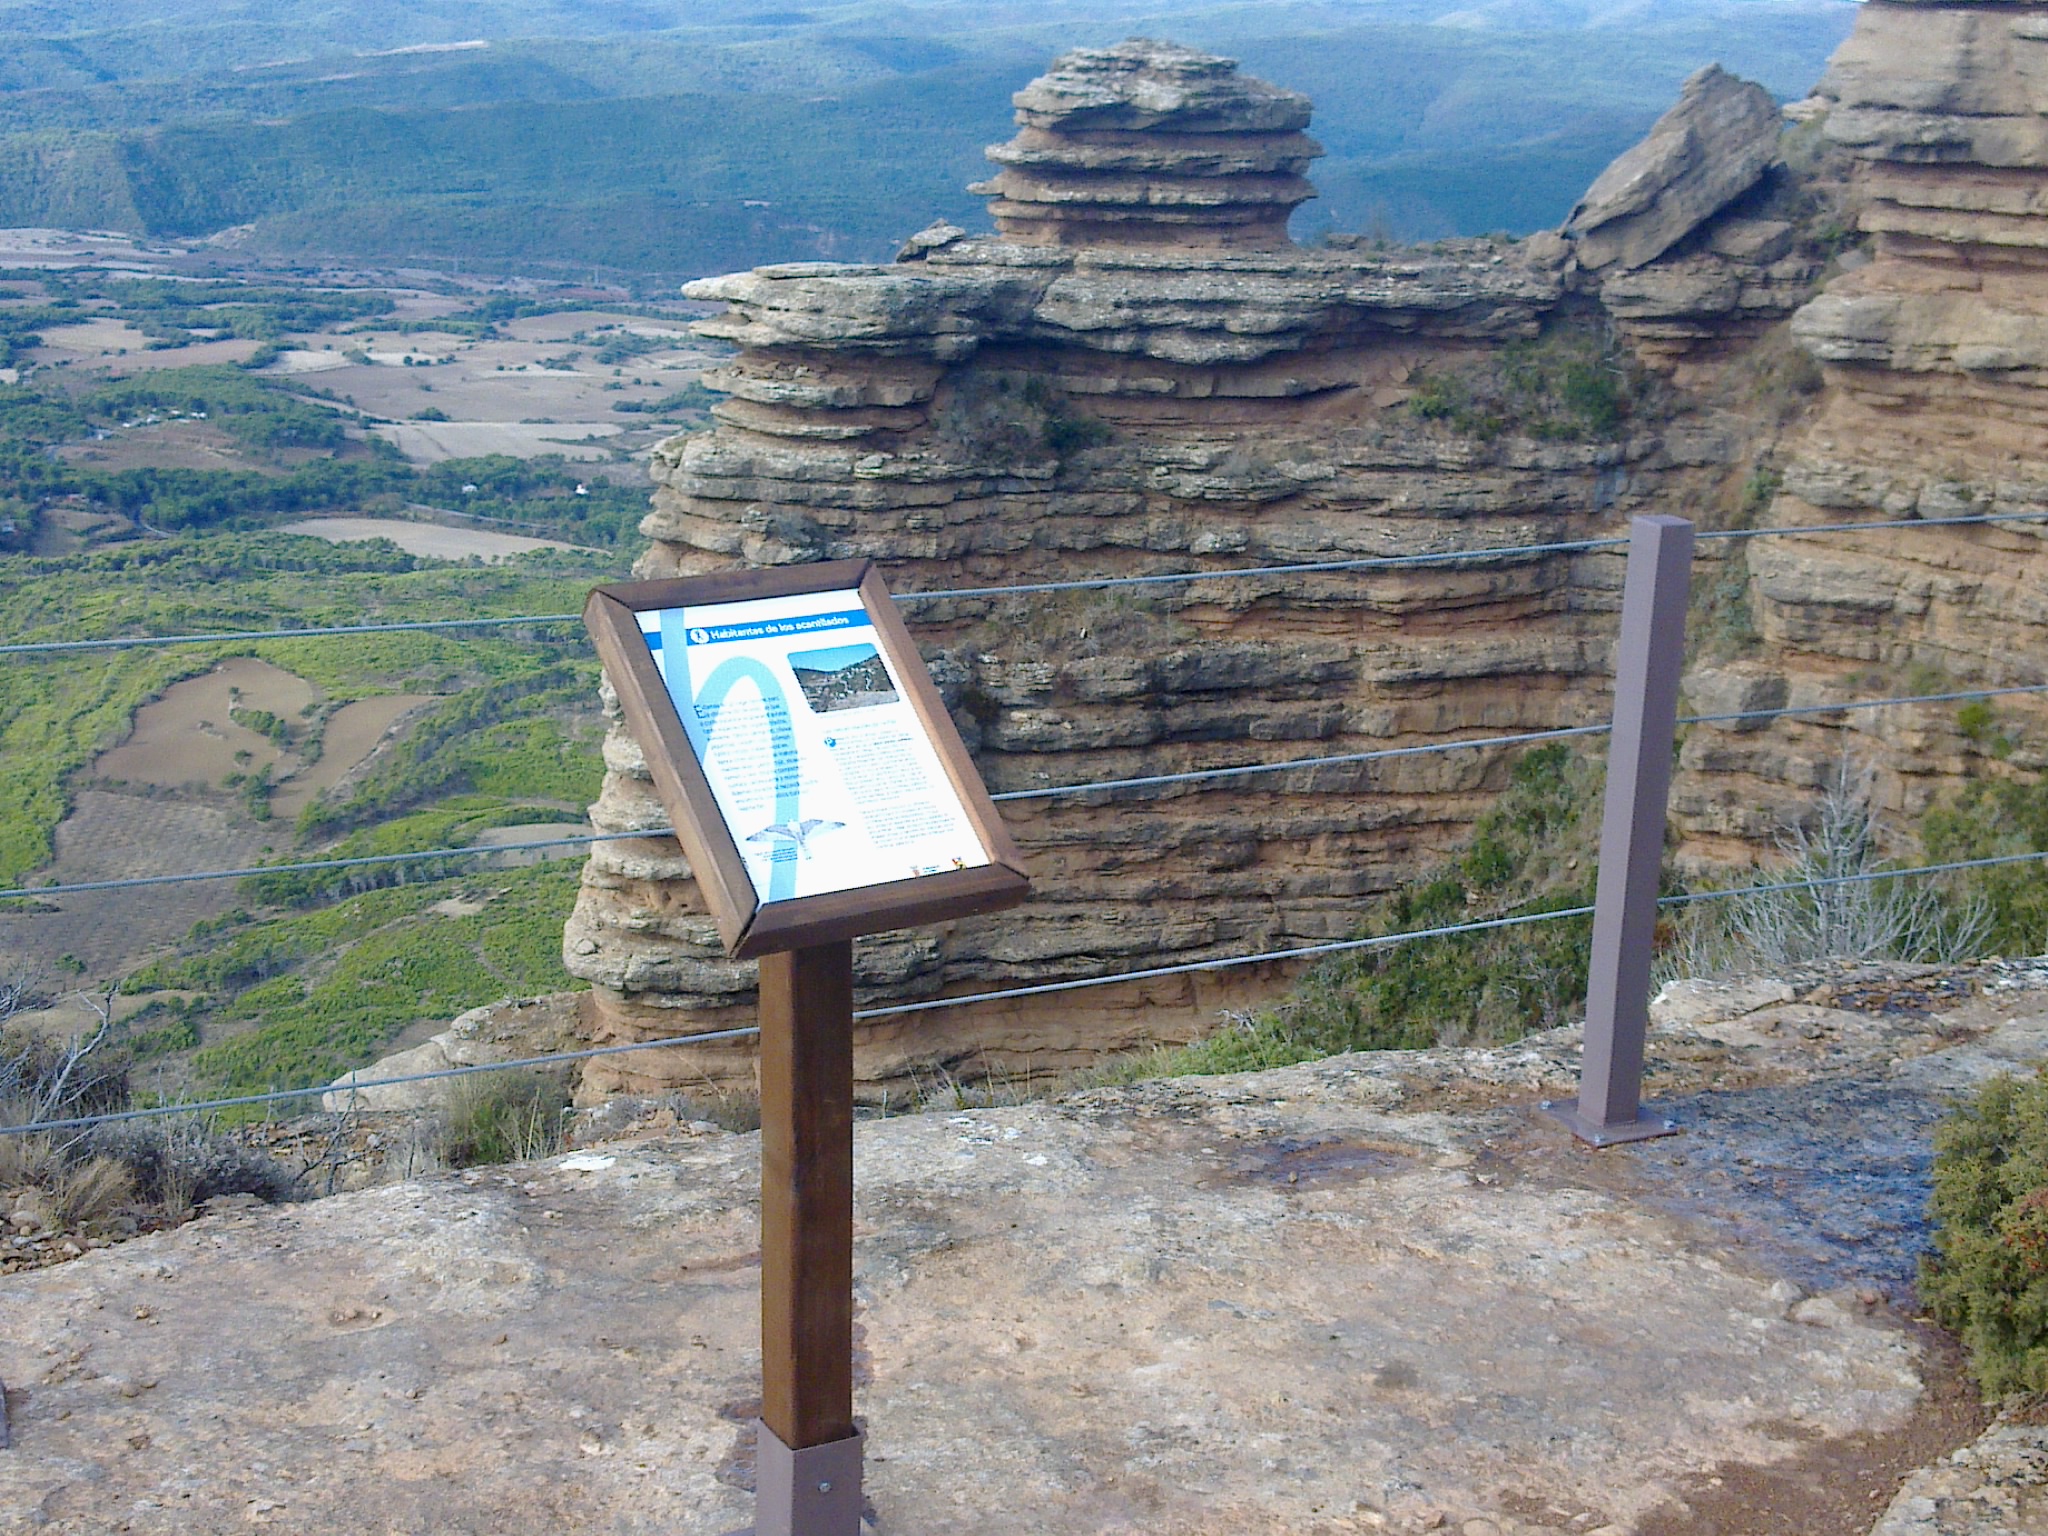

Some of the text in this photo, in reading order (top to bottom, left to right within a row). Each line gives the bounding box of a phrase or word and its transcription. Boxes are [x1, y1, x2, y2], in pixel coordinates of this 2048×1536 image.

[710, 628, 764, 640] Habitantes
[765, 624, 778, 633] de
[778, 623, 795, 631] los
